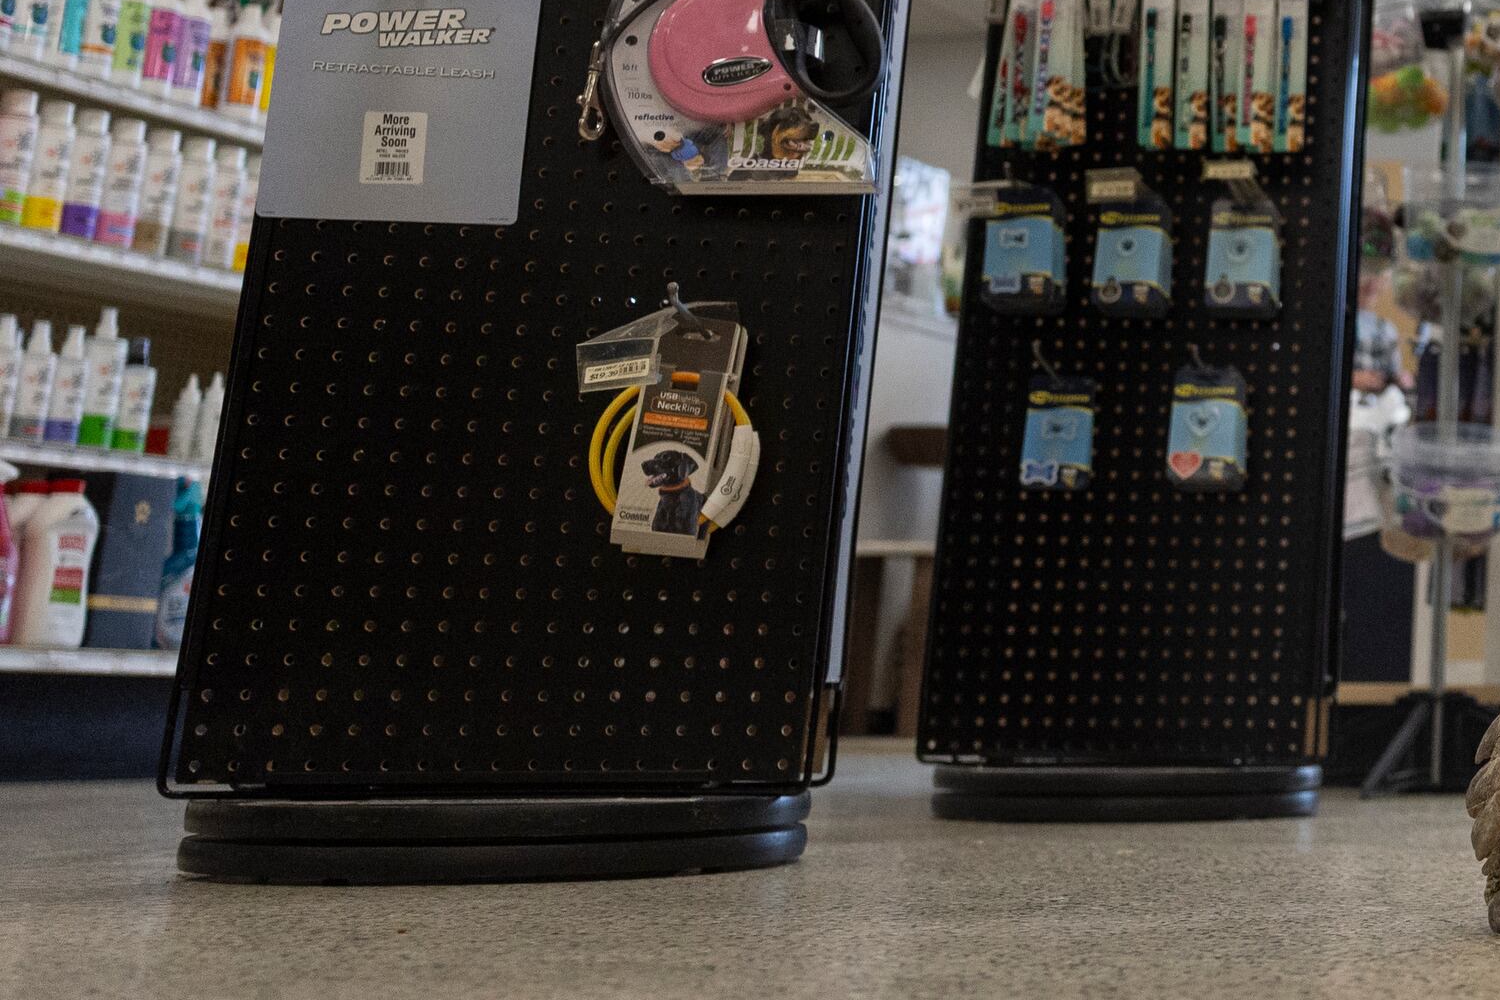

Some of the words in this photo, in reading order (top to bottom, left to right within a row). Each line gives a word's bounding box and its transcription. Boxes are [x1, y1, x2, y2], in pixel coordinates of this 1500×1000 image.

[320, 8, 467, 35] POWER
[378, 28, 492, 48] WALKER
[312, 60, 437, 77] RETRACTABLE
[440, 66, 496, 80] LEASH
[714, 62, 755, 75] POWER
[383, 113, 410, 125] More
[634, 113, 675, 121] reflective
[374, 125, 416, 139] Arriving
[381, 136, 407, 147] Soon
[727, 156, 806, 171] Coastal
[660, 391, 679, 400] USB
